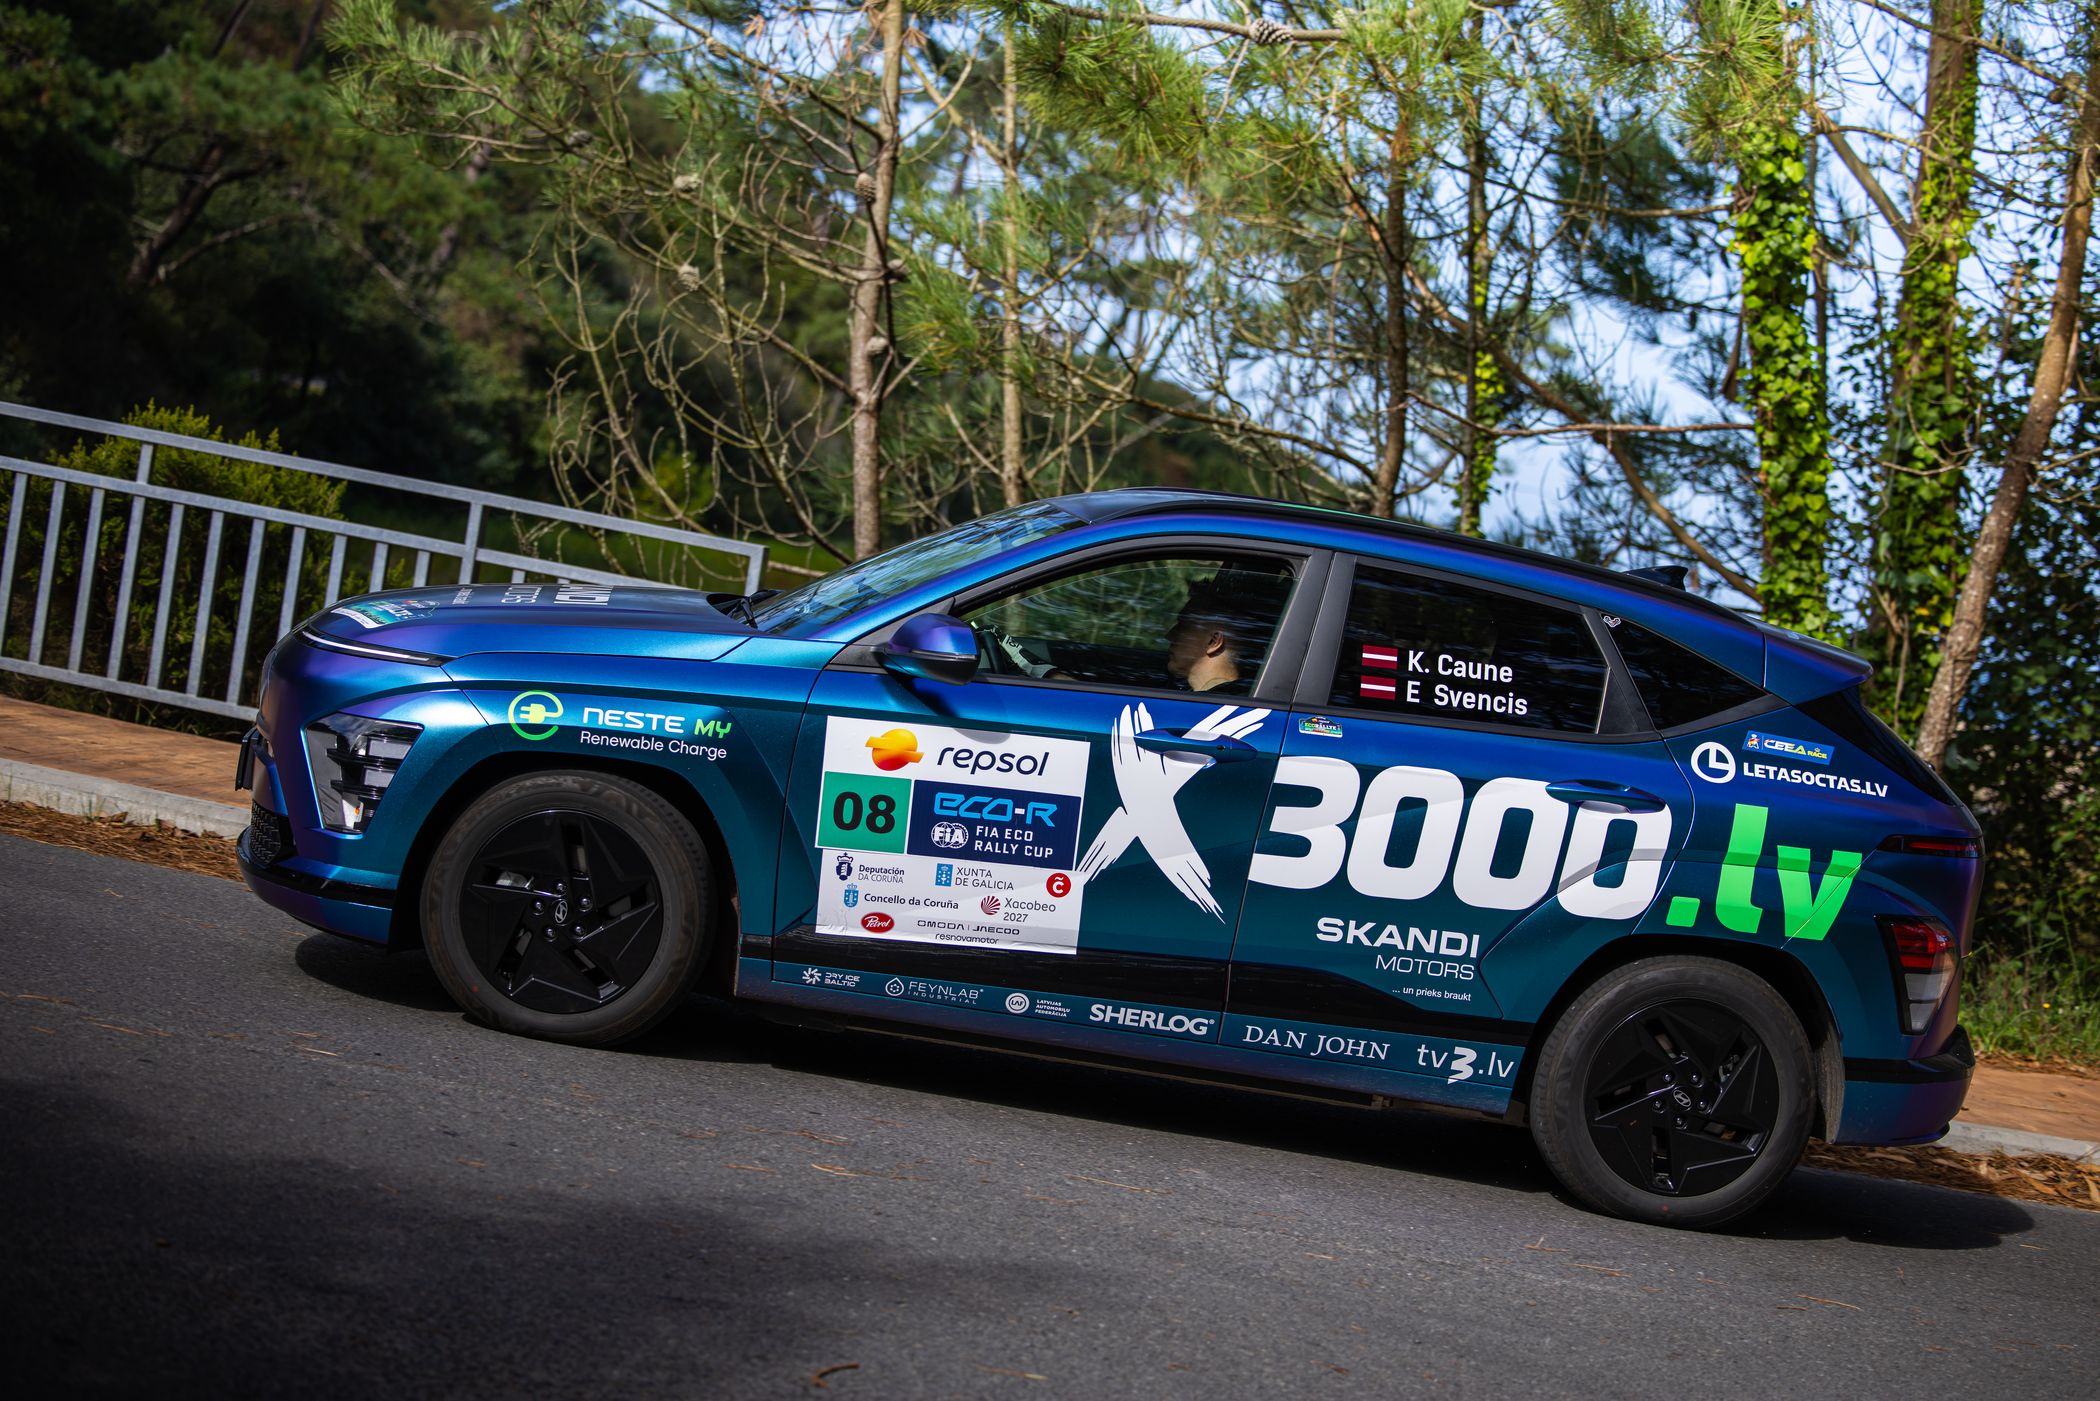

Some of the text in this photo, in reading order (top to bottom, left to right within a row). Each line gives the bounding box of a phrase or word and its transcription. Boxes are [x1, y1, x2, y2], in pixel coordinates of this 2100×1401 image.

[1408, 650, 1513, 683] K. Caune
[1406, 681, 1529, 716] E Svencis
[582, 707, 732, 739] NESTE MY
[580, 731, 728, 761] Renewable Charge
[936, 746, 1050, 777] repsol
[1743, 762, 1888, 797] LETASOCTAS.LV
[832, 791, 897, 834] 08
[976, 825, 1033, 842] FIA ECO
[974, 840, 1054, 858] RALLY CUP
[857, 873, 904, 884] DA CORUÑA
[858, 864, 905, 877] Deputación
[956, 866, 993, 878] XUNTA
[955, 877, 1015, 891] DE GALICIA
[863, 893, 959, 910] Concello da Coruña
[1004, 897, 1057, 913] Xacobeo
[1003, 911, 1029, 923] 2027
[917, 920, 1021, 935] OMODA JAECOO
[935, 932, 999, 945] resnovamotor
[1315, 916, 1480, 958] SKANDI
[1375, 954, 1475, 980] MOTORS
[907, 991, 978, 1006] INDUSTRIAL
[1403, 986, 1414, 995] un
[1416, 987, 1442, 1000] prieks
[1444, 991, 1472, 1001] braukt
[1243, 1025, 1391, 1061] DAN JOHN
[1416, 1043, 1515, 1085] tv3.lv
